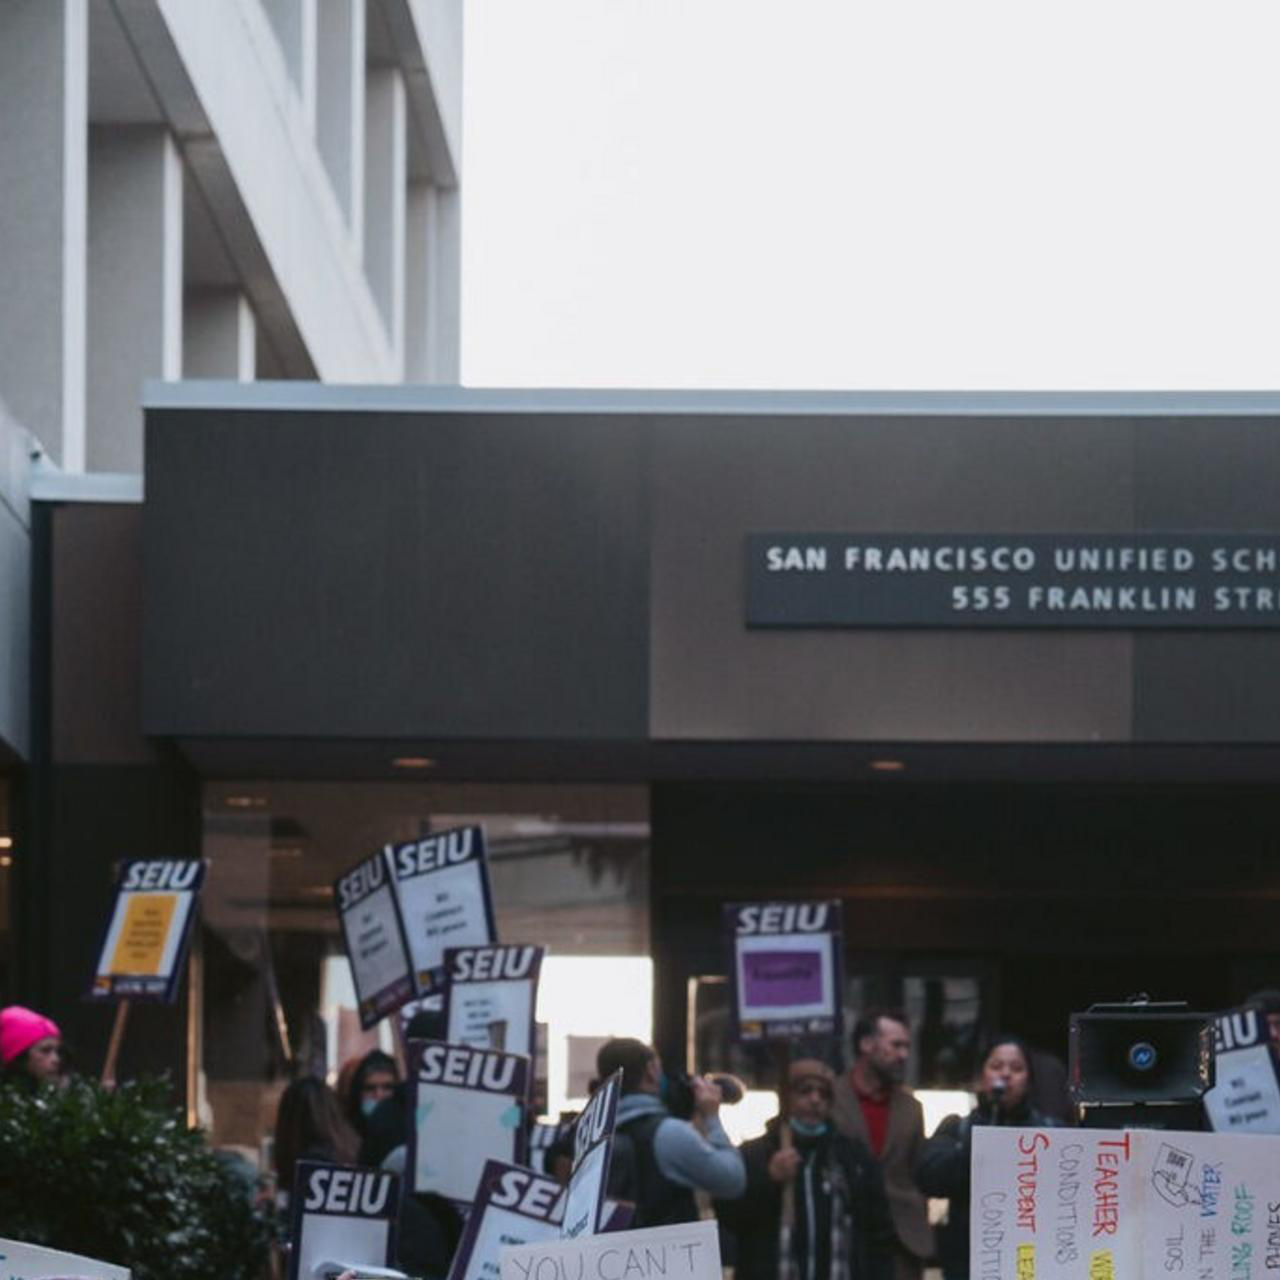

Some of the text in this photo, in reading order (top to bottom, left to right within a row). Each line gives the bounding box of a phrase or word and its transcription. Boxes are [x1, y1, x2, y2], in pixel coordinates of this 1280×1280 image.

[766, 547, 828, 572] SAN
[845, 547, 1036, 573] FRANCISCO
[1054, 547, 1196, 573] UNIFIED
[952, 586, 1011, 611] 555
[1028, 586, 1197, 611] FRANKLIN
[122, 860, 199, 888] SEIU
[398, 827, 473, 876] SEIU
[340, 853, 384, 909] SEIU
[736, 903, 828, 933] SEIU
[452, 948, 534, 980] SEIU
[419, 1047, 517, 1090] SEIU
[305, 1168, 391, 1214] SEIU
[1016, 1132, 1050, 1234] STUDENT
[1056, 1143, 1084, 1265] CONDITIONS
[1093, 1132, 1130, 1238] TEACHER
[1199, 1161, 1222, 1218] WATER
[1164, 1226, 1184, 1272] SOIL
[1198, 1228, 1216, 1262] THE
